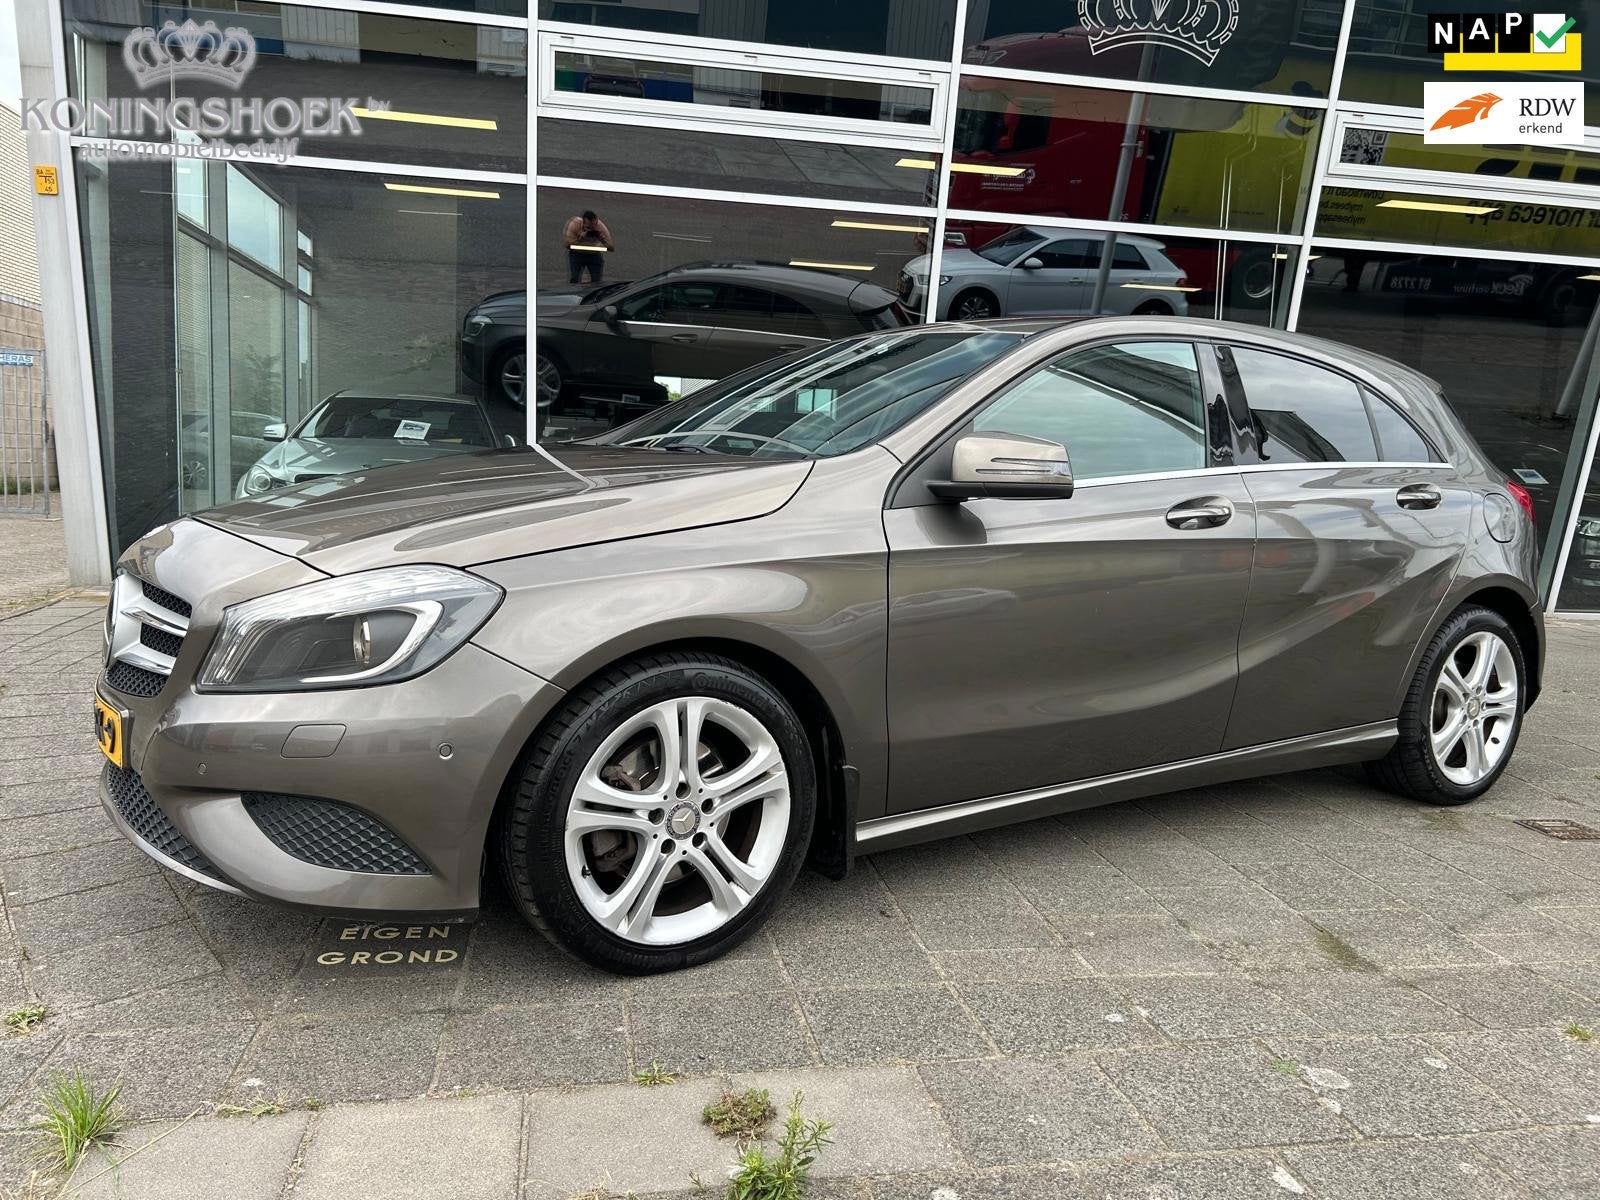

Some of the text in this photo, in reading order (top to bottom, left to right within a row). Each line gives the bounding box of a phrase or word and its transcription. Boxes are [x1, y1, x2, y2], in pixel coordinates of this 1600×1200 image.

[0, 354, 32, 363] HERAS
[339, 926, 450, 940] EIGEN
[316, 949, 458, 965] GROND
